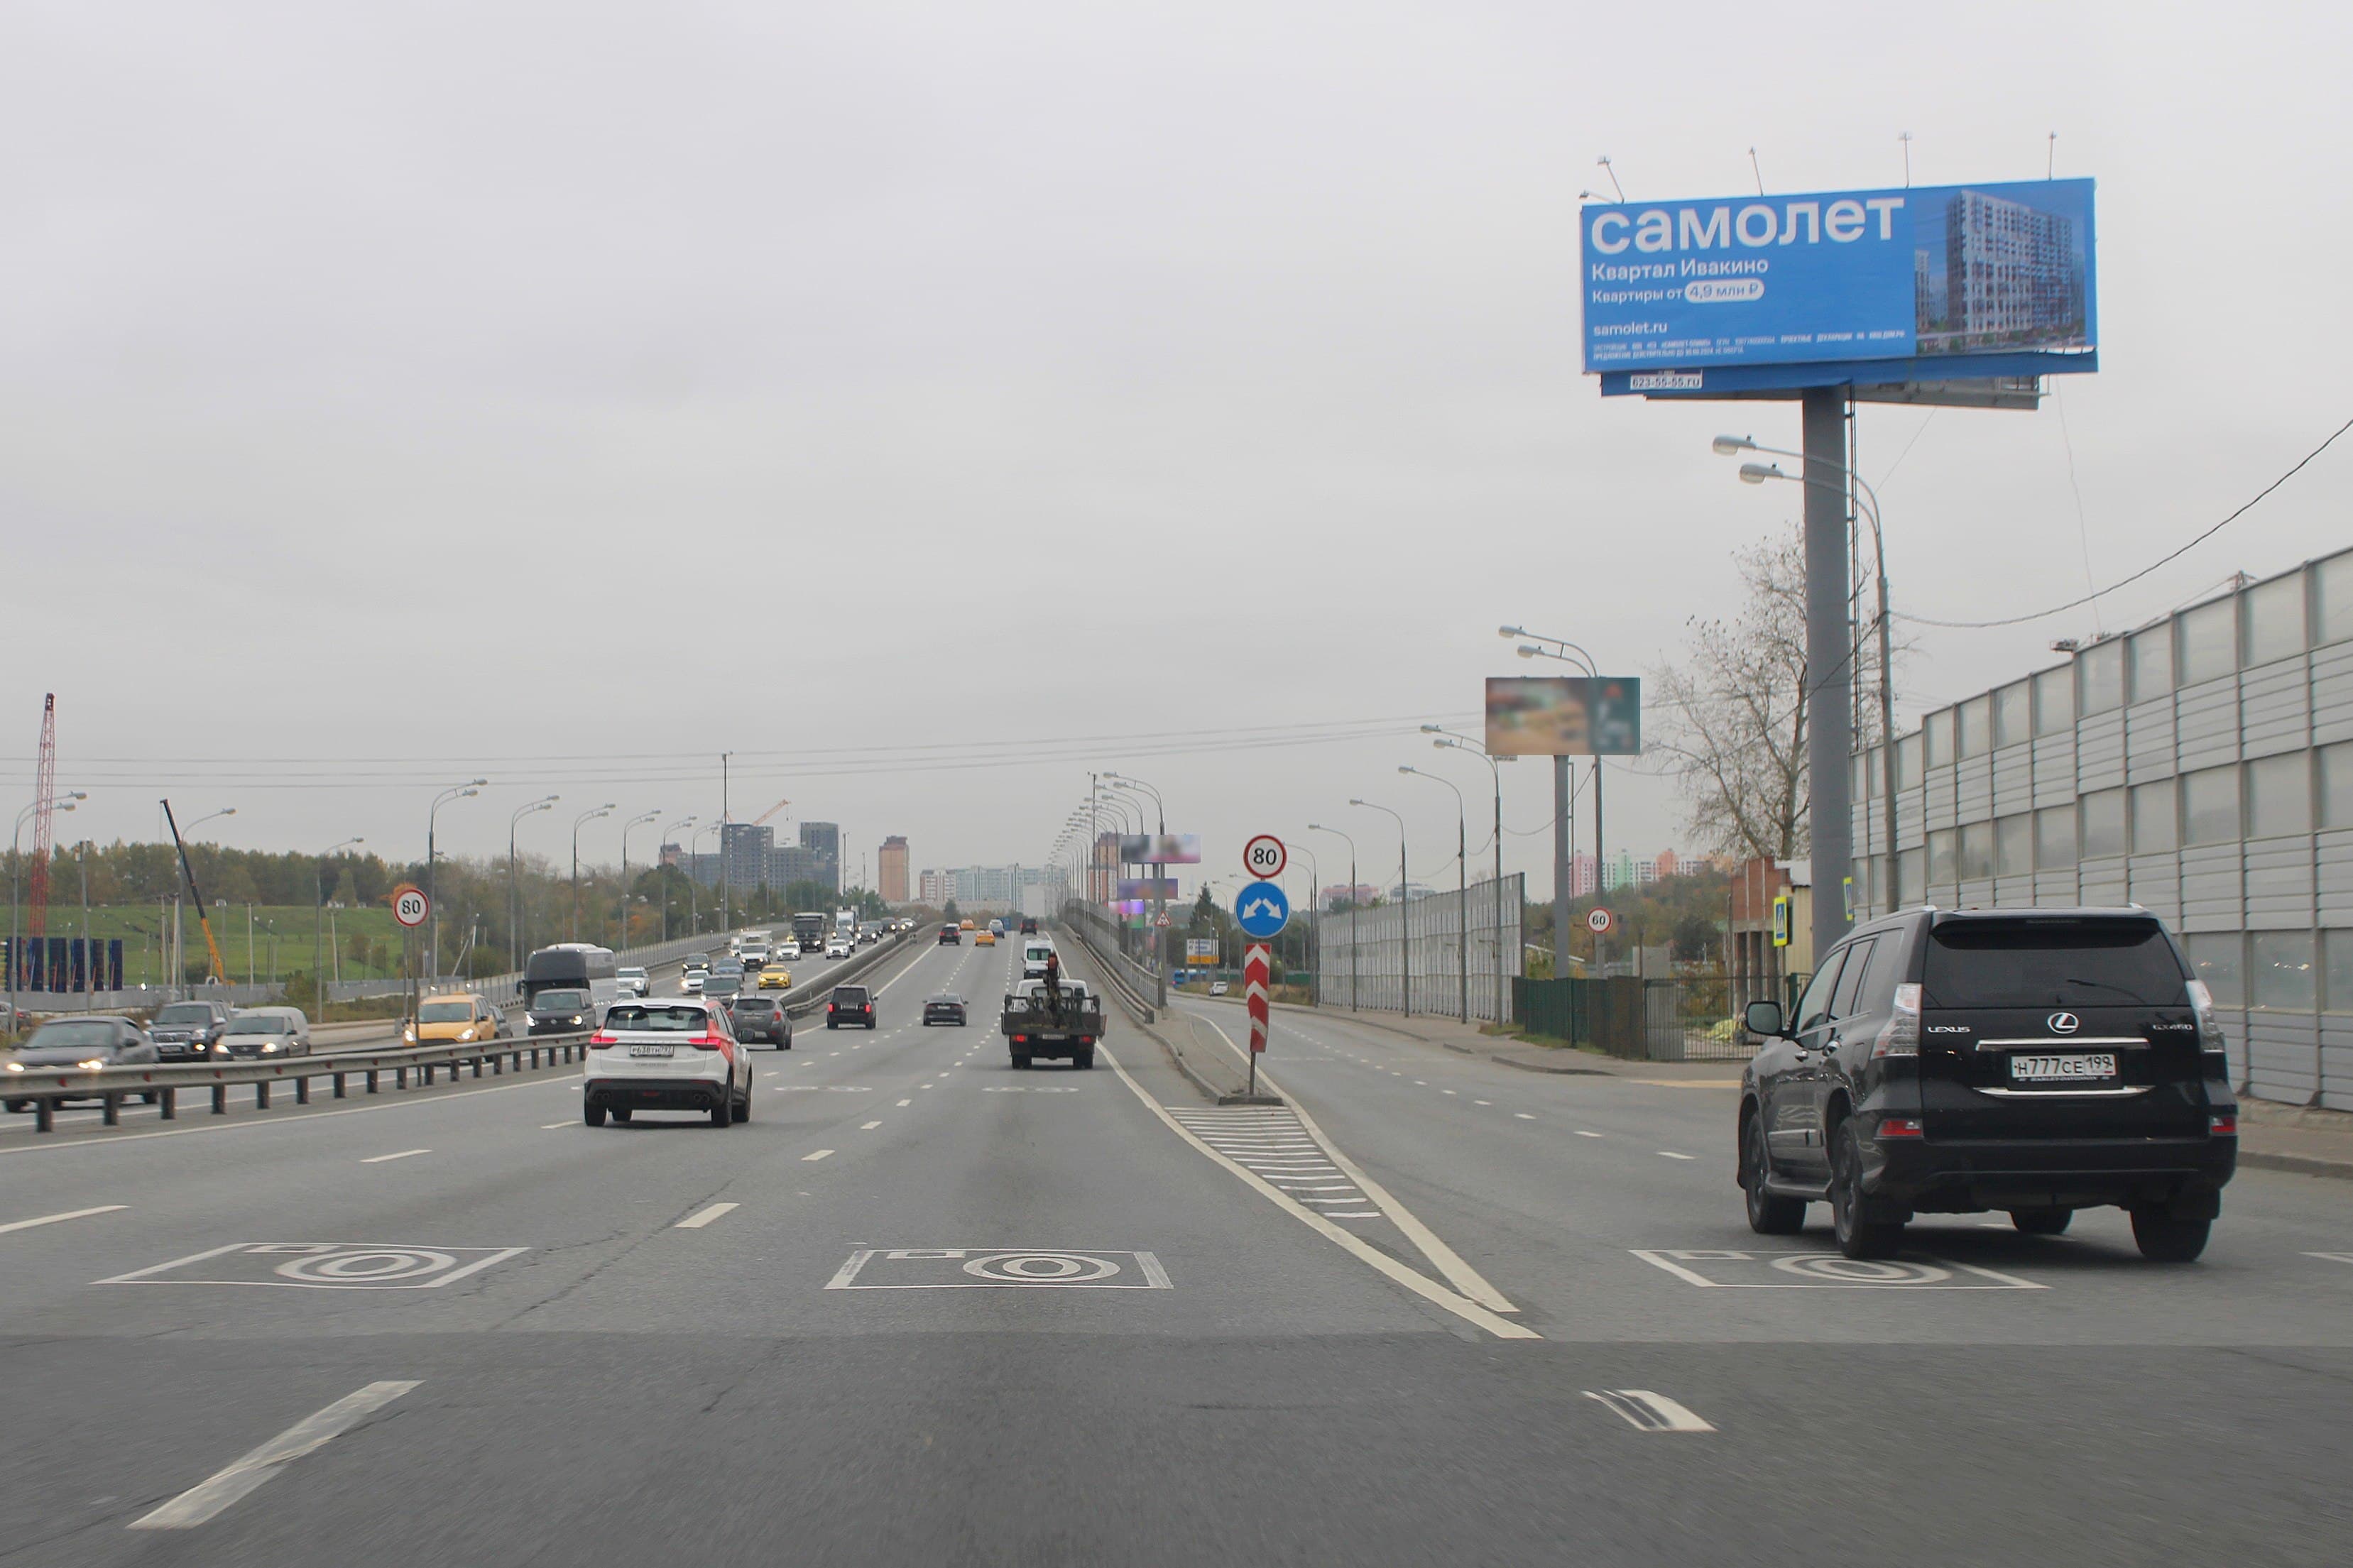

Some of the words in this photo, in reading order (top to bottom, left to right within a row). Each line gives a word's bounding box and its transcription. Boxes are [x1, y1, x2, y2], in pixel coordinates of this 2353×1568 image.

[1591, 197, 1904, 254] самолет
[1592, 263, 1676, 283] Квартал
[1681, 258, 1769, 277] Ивакино
[1593, 289, 1664, 305] Квартиры
[1666, 287, 1683, 300] от
[1689, 285, 1713, 300] 4,9
[1715, 287, 1745, 297] млн
[1593, 322, 1668, 336] samolet.ru
[1253, 848, 1277, 865] 80
[402, 899, 420, 914] 80
[1593, 915, 1606, 925] 60
[2086, 1056, 2110, 1068] 199
